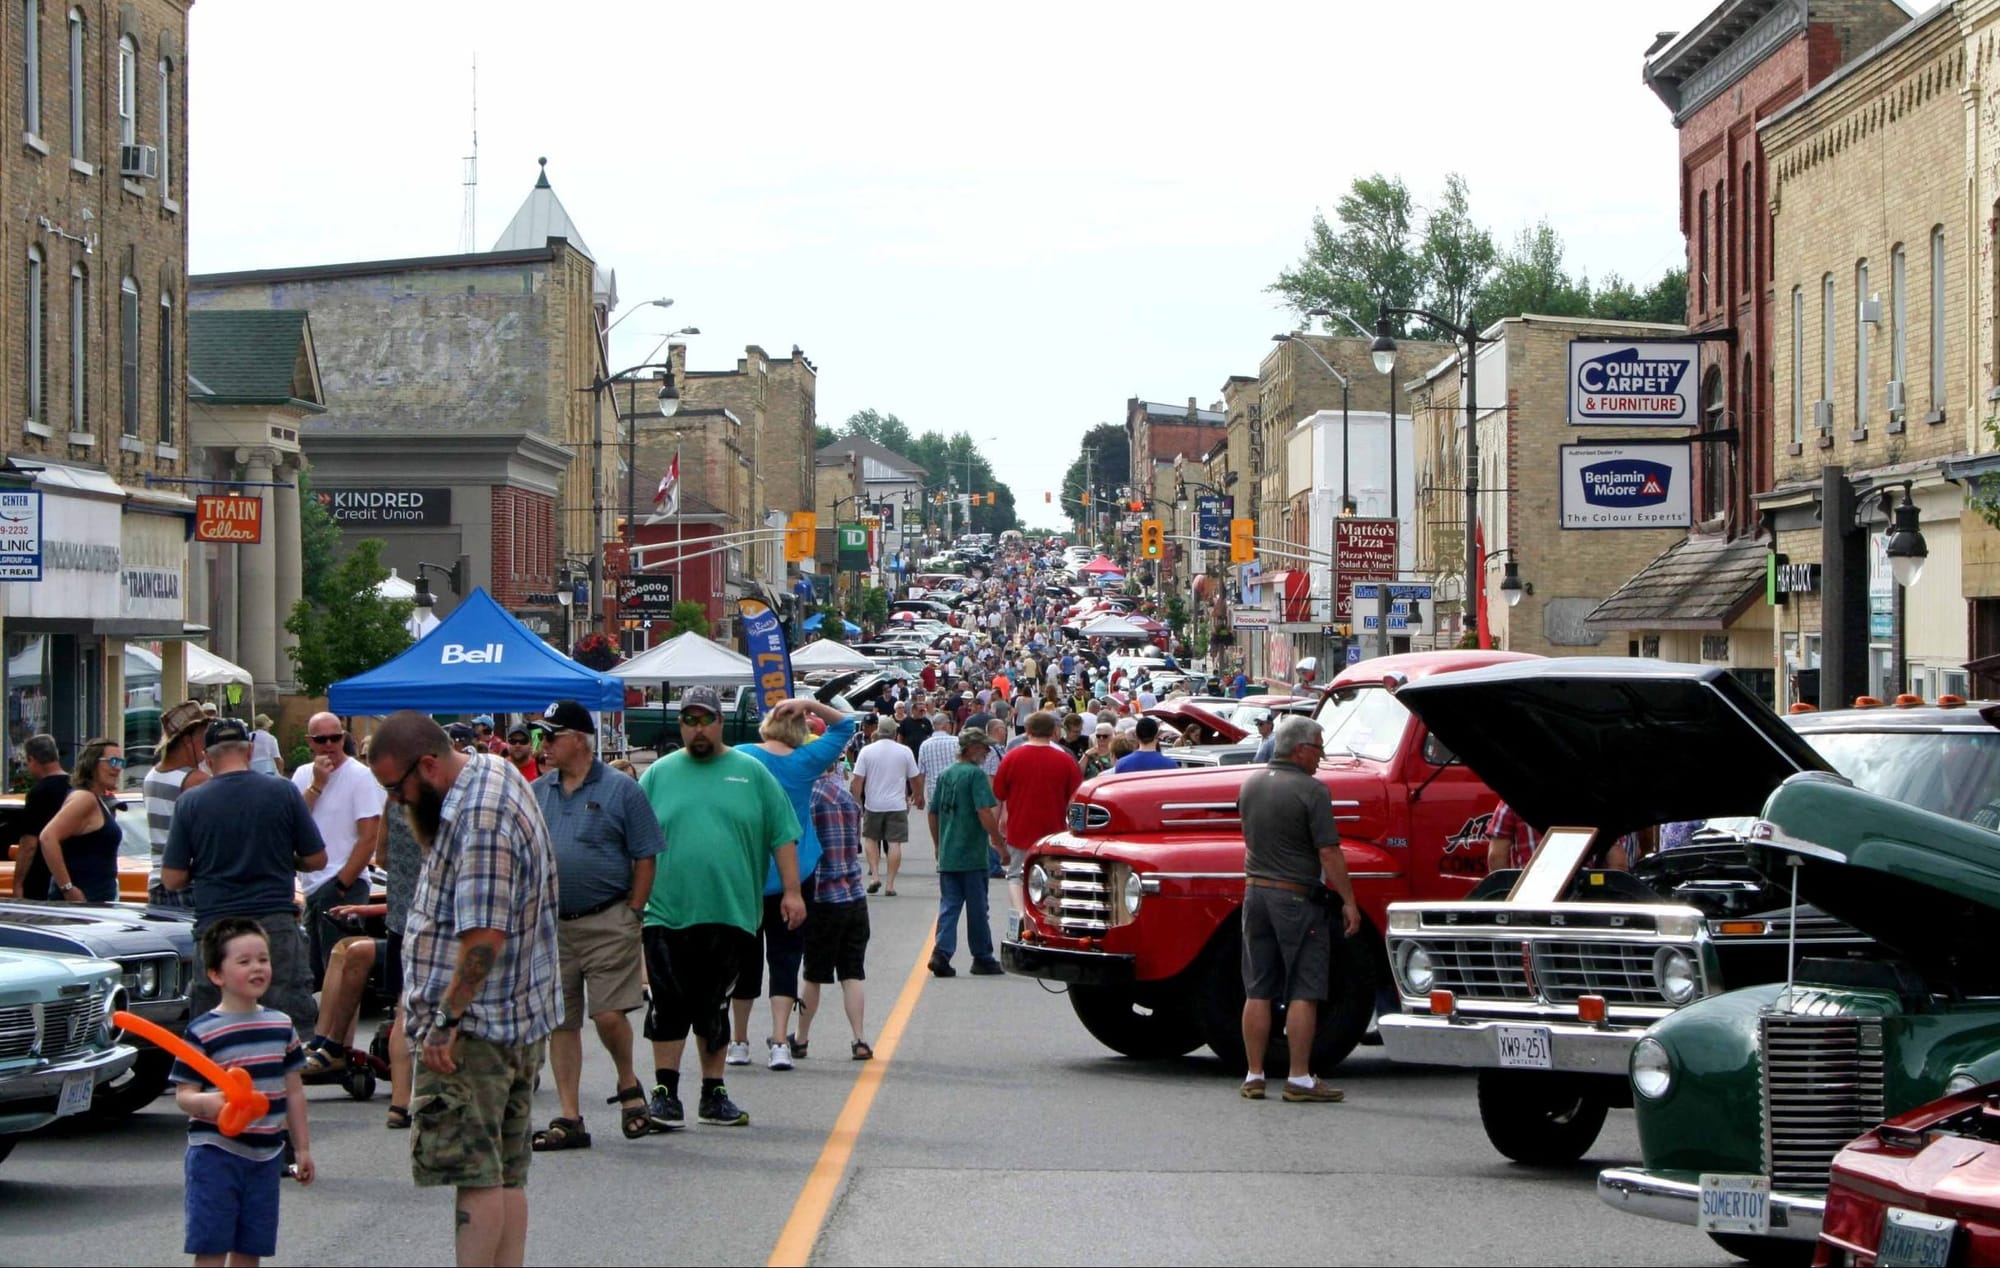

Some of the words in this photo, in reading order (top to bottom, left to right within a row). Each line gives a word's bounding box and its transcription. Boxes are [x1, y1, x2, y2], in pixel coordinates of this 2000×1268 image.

[1579, 361, 1682, 392] COUNTRY
[1585, 397, 1596, 411] &
[1600, 397, 1678, 412] FURNITURE
[1585, 470, 1646, 486] Benjamin
[1594, 484, 1637, 496] Moore
[334, 492, 424, 508] KINDRED
[202, 500, 257, 521] TRAIN
[335, 508, 377, 520] Credit
[382, 508, 424, 520] Union
[1567, 514, 1588, 523] The
[1592, 513, 1632, 522] Colour
[1637, 513, 1682, 523] Experts
[199, 520, 255, 540] Cellar
[842, 529, 866, 546] TD
[1338, 523, 1395, 537] Mattéo's
[1348, 536, 1384, 548] Pizza
[1340, 551, 1362, 560] Pizza
[9, 568, 33, 576] REAR
[1340, 560, 1361, 569] Salad
[1362, 561, 1369, 569] &
[1791, 563, 1812, 592] BLOCK
[128, 571, 151, 599] TRAIN
[152, 572, 179, 600] CELLAR
[643, 594, 670, 602] BAD!
[441, 643, 504, 665] Bell
[1445, 913, 1625, 926] FORD
[1703, 1189, 1766, 1218] SOMERTOY
